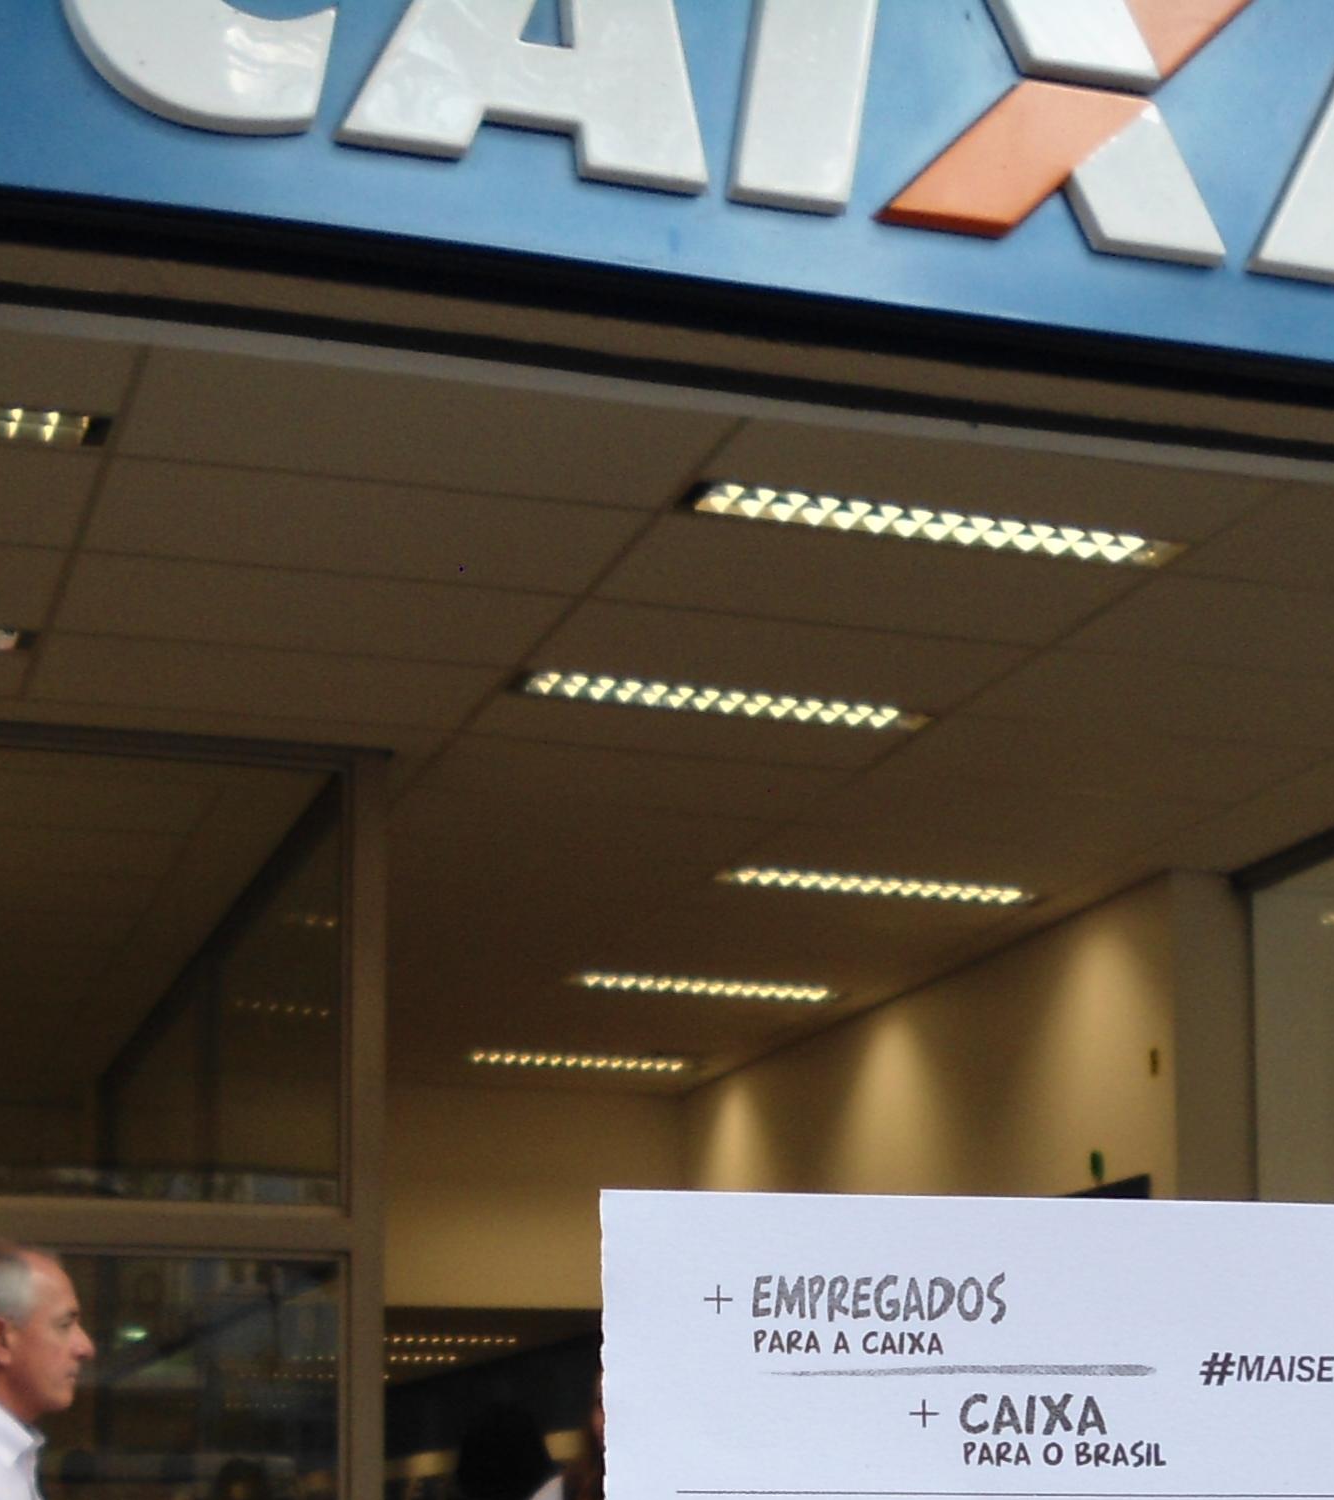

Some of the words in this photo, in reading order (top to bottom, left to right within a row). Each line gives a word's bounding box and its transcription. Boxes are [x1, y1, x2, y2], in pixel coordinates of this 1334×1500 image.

[752, 1272, 1008, 1325] EMPREGADOS
[753, 1329, 821, 1355] PARA
[832, 1330, 851, 1355] A
[862, 1331, 945, 1356] CAIXA
[958, 1393, 1108, 1437] CAIXA
[963, 1441, 1032, 1467] PARA
[1042, 1442, 1064, 1466] O
[1074, 1440, 1167, 1468] BRASIL
